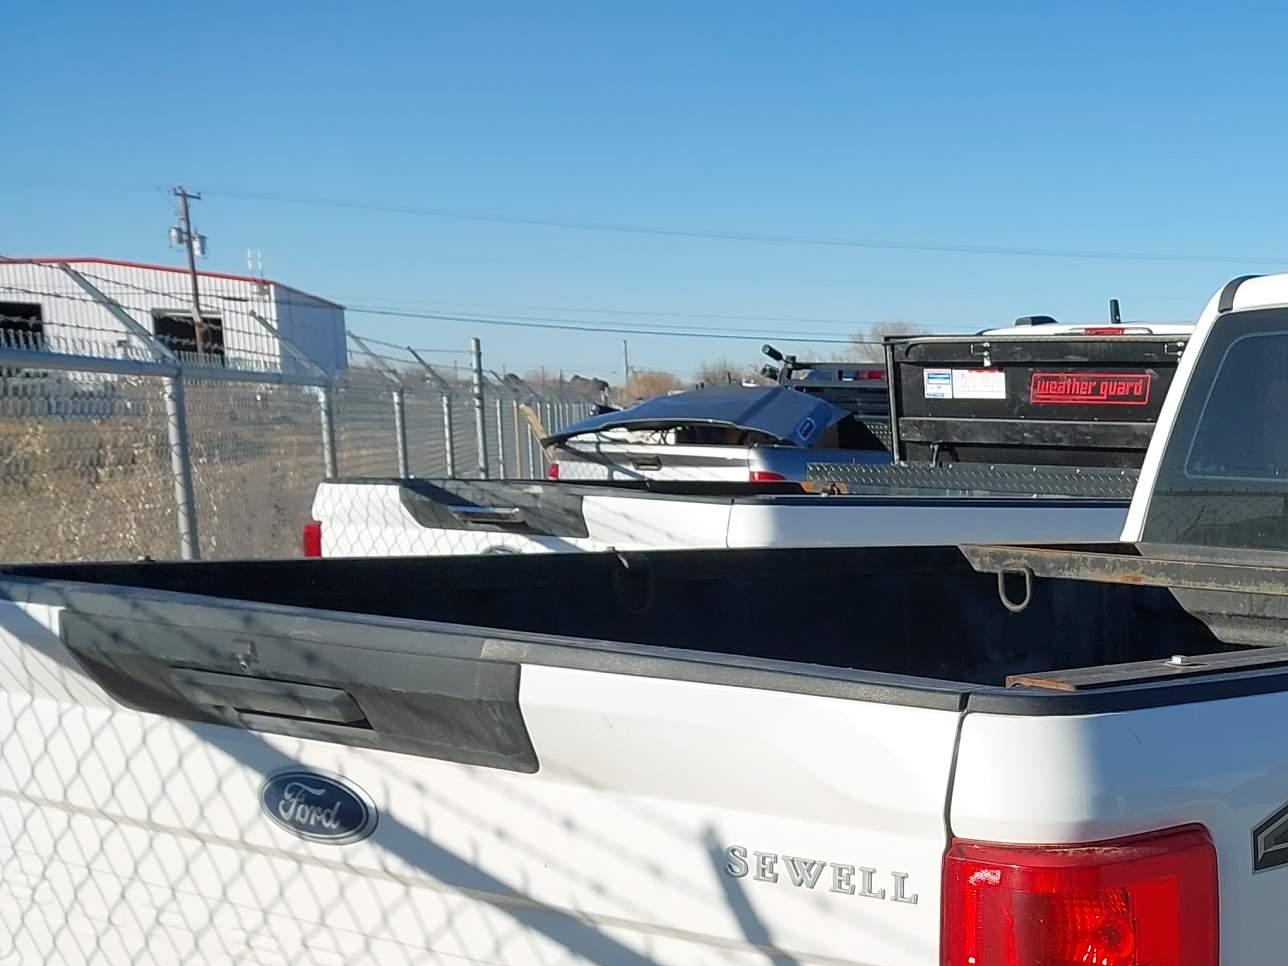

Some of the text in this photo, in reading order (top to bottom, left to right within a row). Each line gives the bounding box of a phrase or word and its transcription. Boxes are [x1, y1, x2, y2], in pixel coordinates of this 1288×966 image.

[1036, 378, 1143, 400] weather guard
[278, 781, 341, 829] Ford
[726, 844, 919, 904] SEWELL
